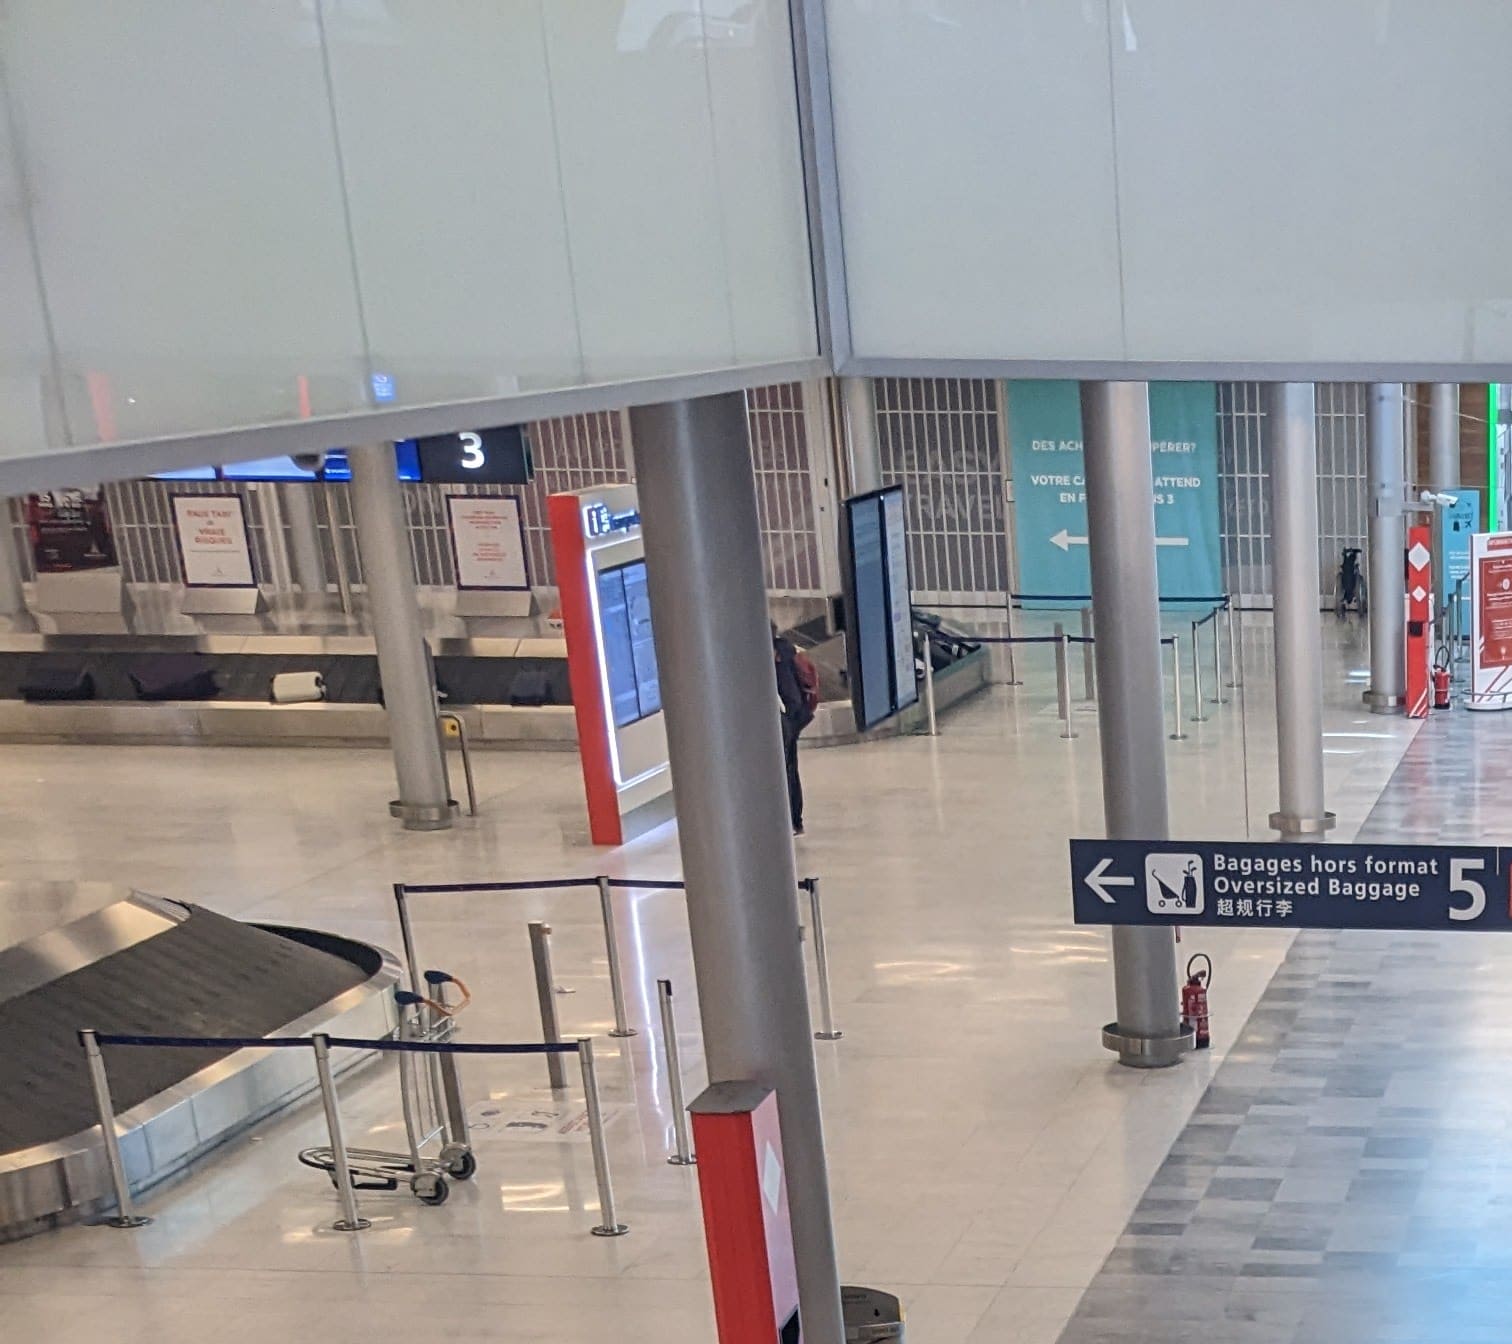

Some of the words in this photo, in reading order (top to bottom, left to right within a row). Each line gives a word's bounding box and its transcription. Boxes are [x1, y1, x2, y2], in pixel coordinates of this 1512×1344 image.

[458, 431, 485, 469] 3
[1032, 440, 1056, 451] DES
[1058, 440, 1084, 452] ACH
[1151, 439, 1197, 453] PÉRER?
[1030, 475, 1071, 486] VOTRE
[1060, 493, 1076, 504] EN
[1167, 494, 1174, 505] 3
[1213, 853, 1302, 876] Bagages
[1310, 855, 1357, 874] hors
[1365, 856, 1438, 875] format
[1213, 876, 1320, 895] Oversized
[1328, 878, 1421, 900] Baggage
[1448, 858, 1487, 921] 5
[1217, 899, 1293, 918] 超规行李
